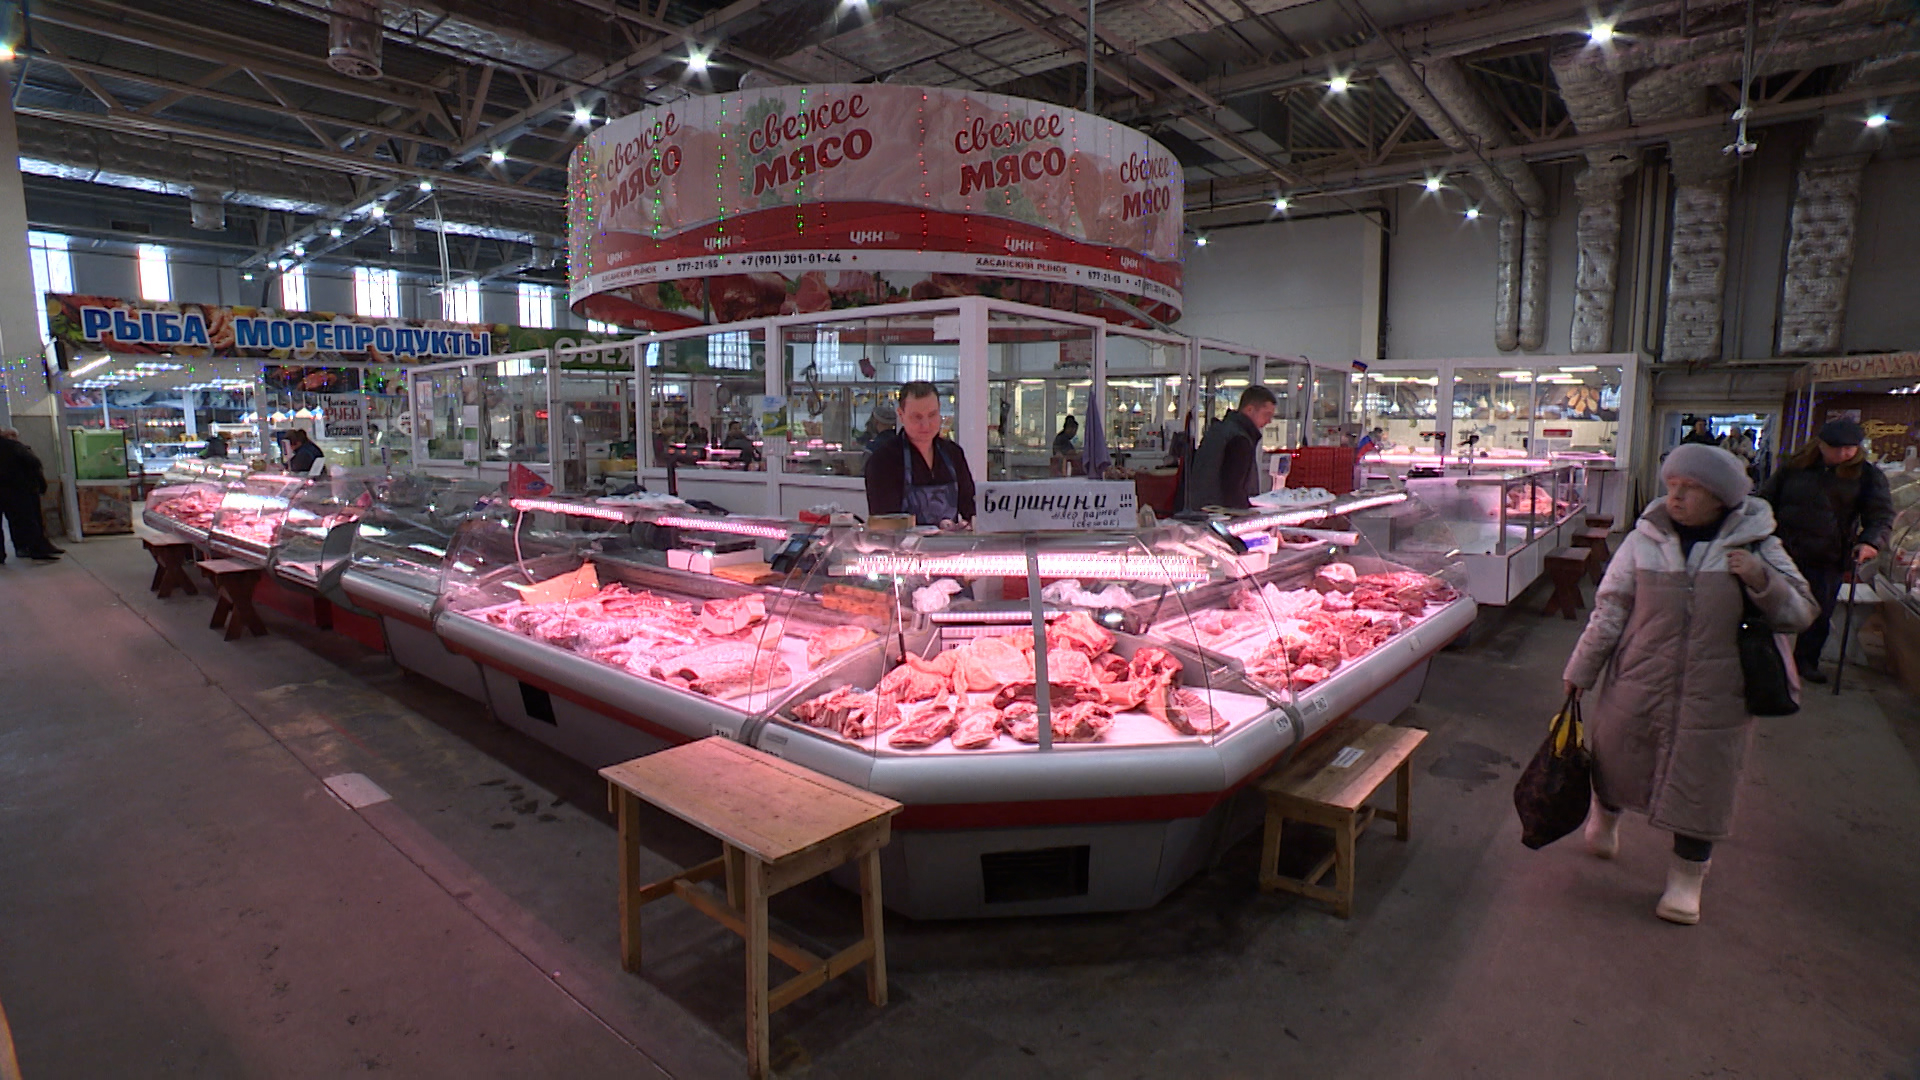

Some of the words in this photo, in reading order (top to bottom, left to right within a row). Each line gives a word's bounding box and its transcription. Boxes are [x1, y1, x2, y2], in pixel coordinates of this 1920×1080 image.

[748, 94, 869, 154] свежее
[954, 113, 1065, 154] свежее
[82, 307, 209, 345] РЫБА
[234, 317, 492, 358] МОРЕПРОДУКТЫ
